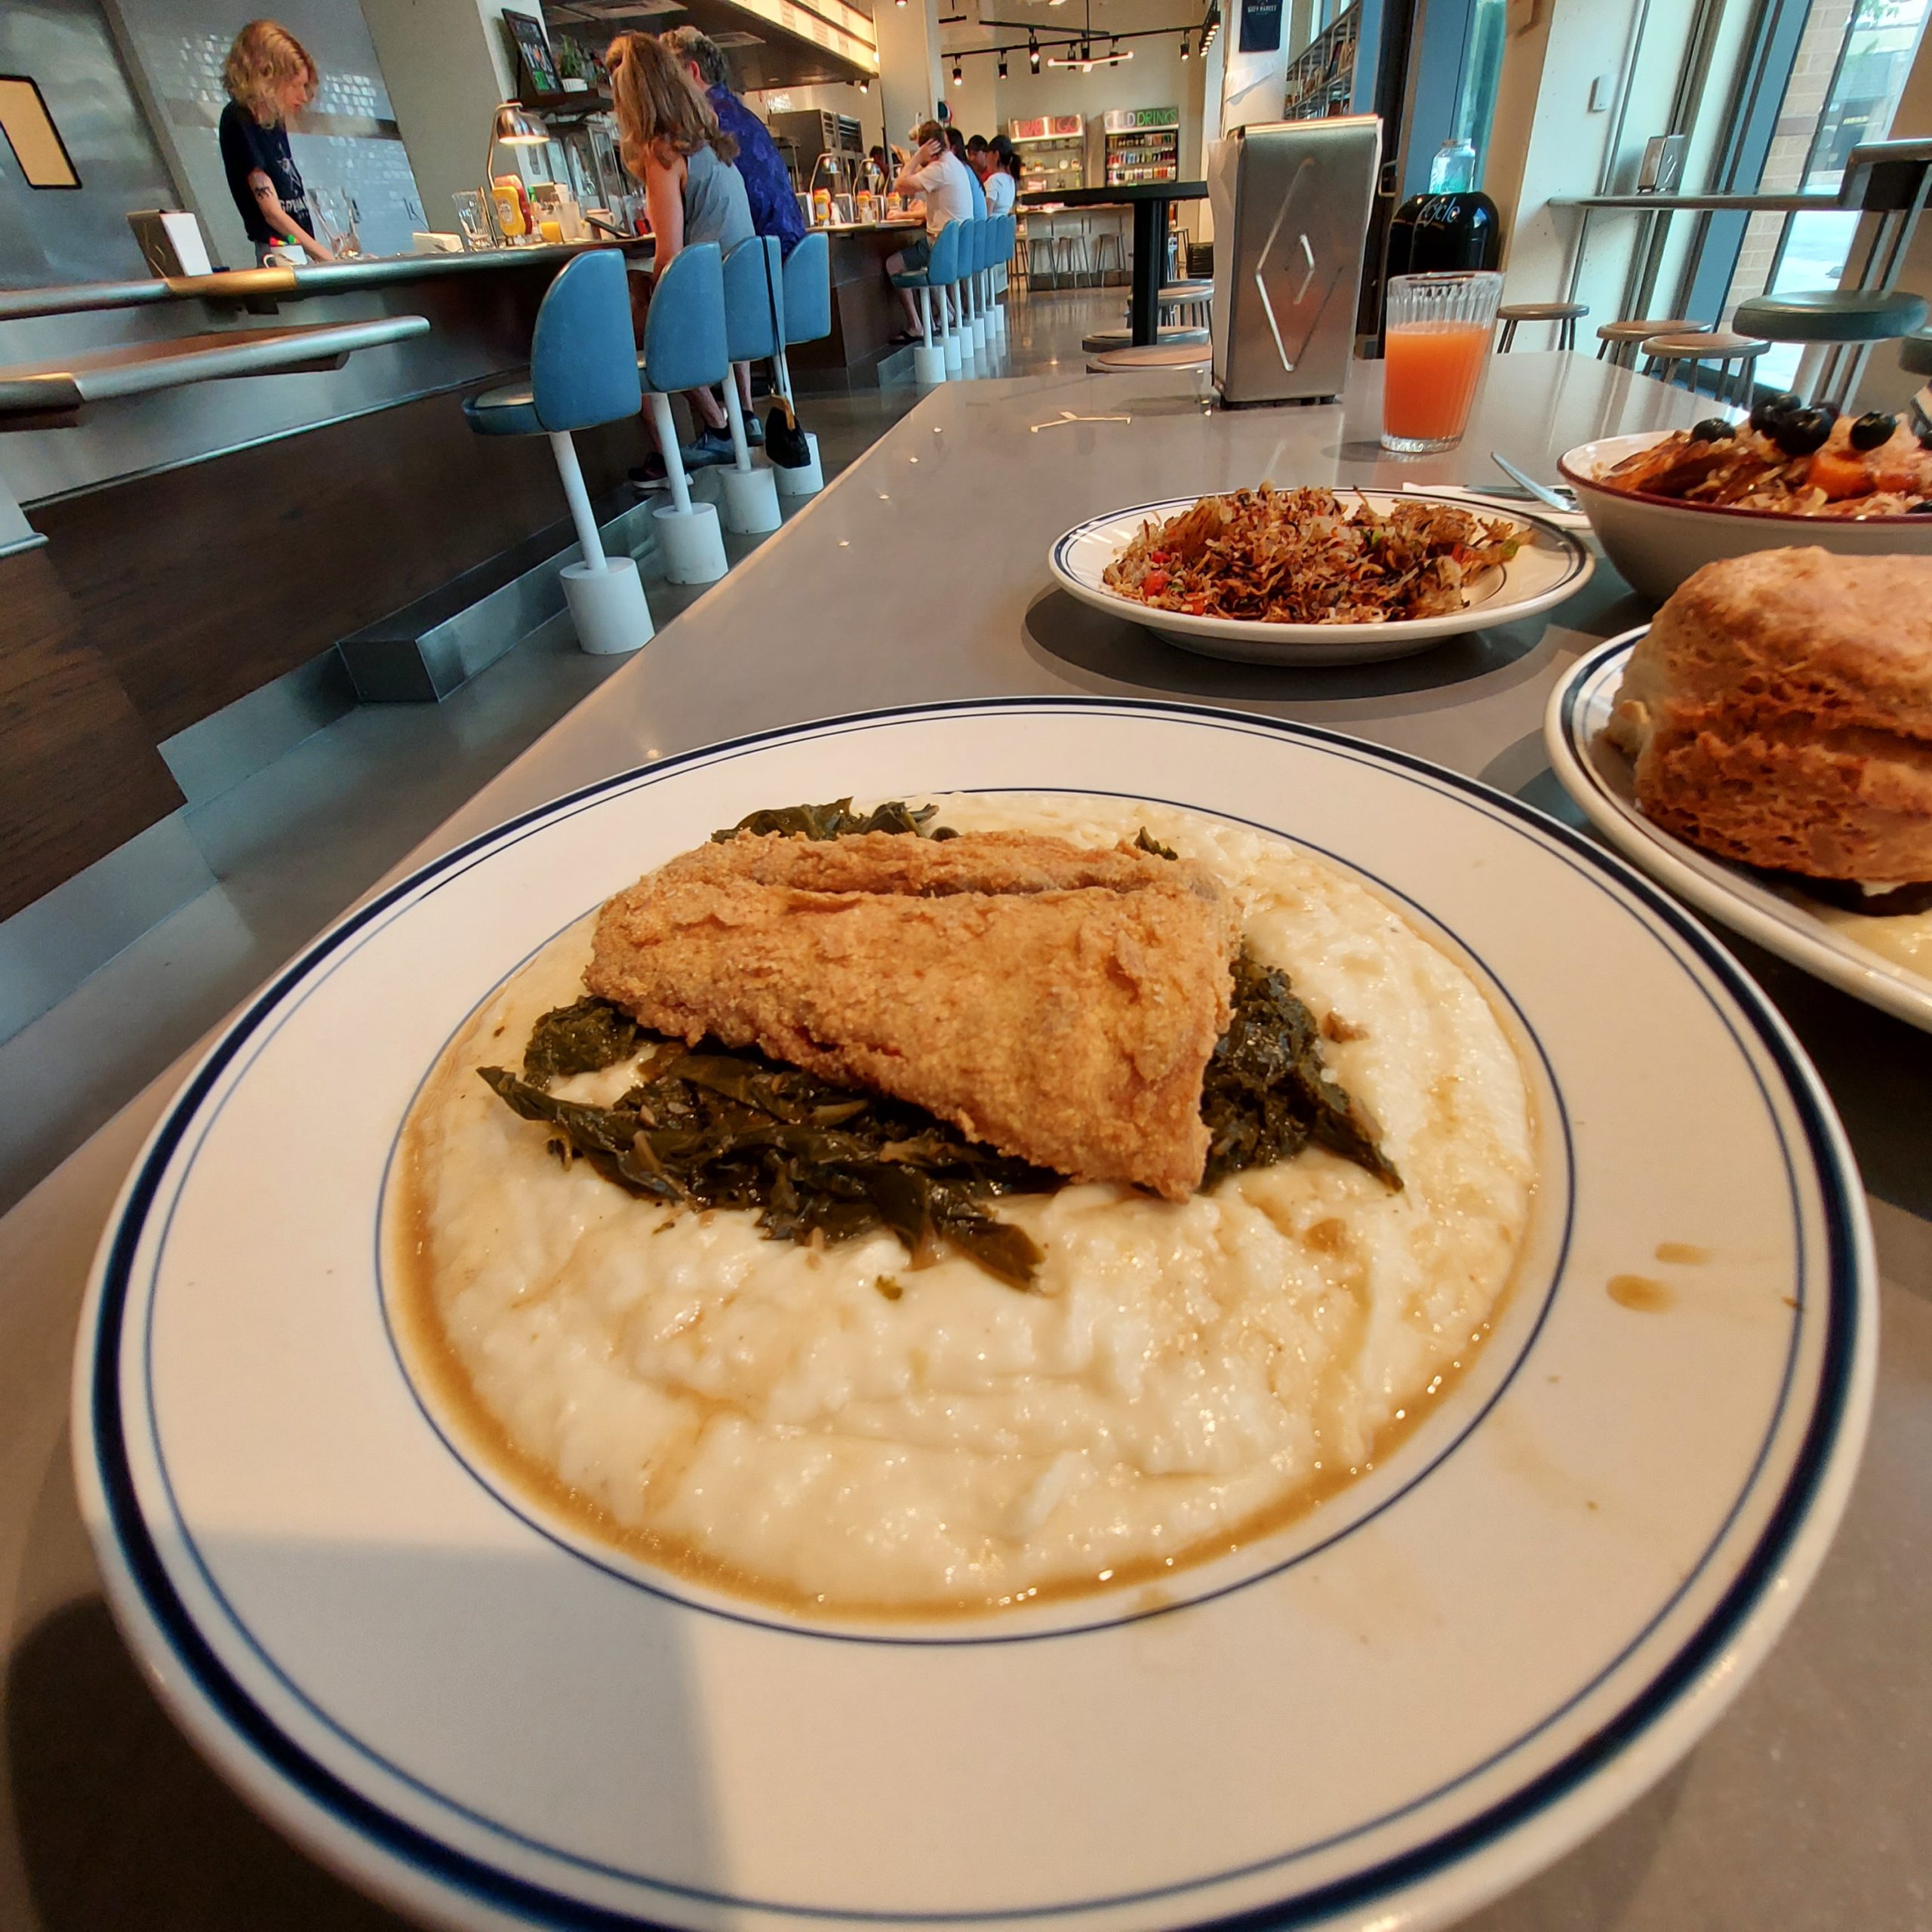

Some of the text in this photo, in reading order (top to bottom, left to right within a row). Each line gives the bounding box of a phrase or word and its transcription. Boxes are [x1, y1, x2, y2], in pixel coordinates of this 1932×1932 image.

[1057, 115, 1081, 133] GO
[1106, 109, 1177, 129] CLD DRINKS
